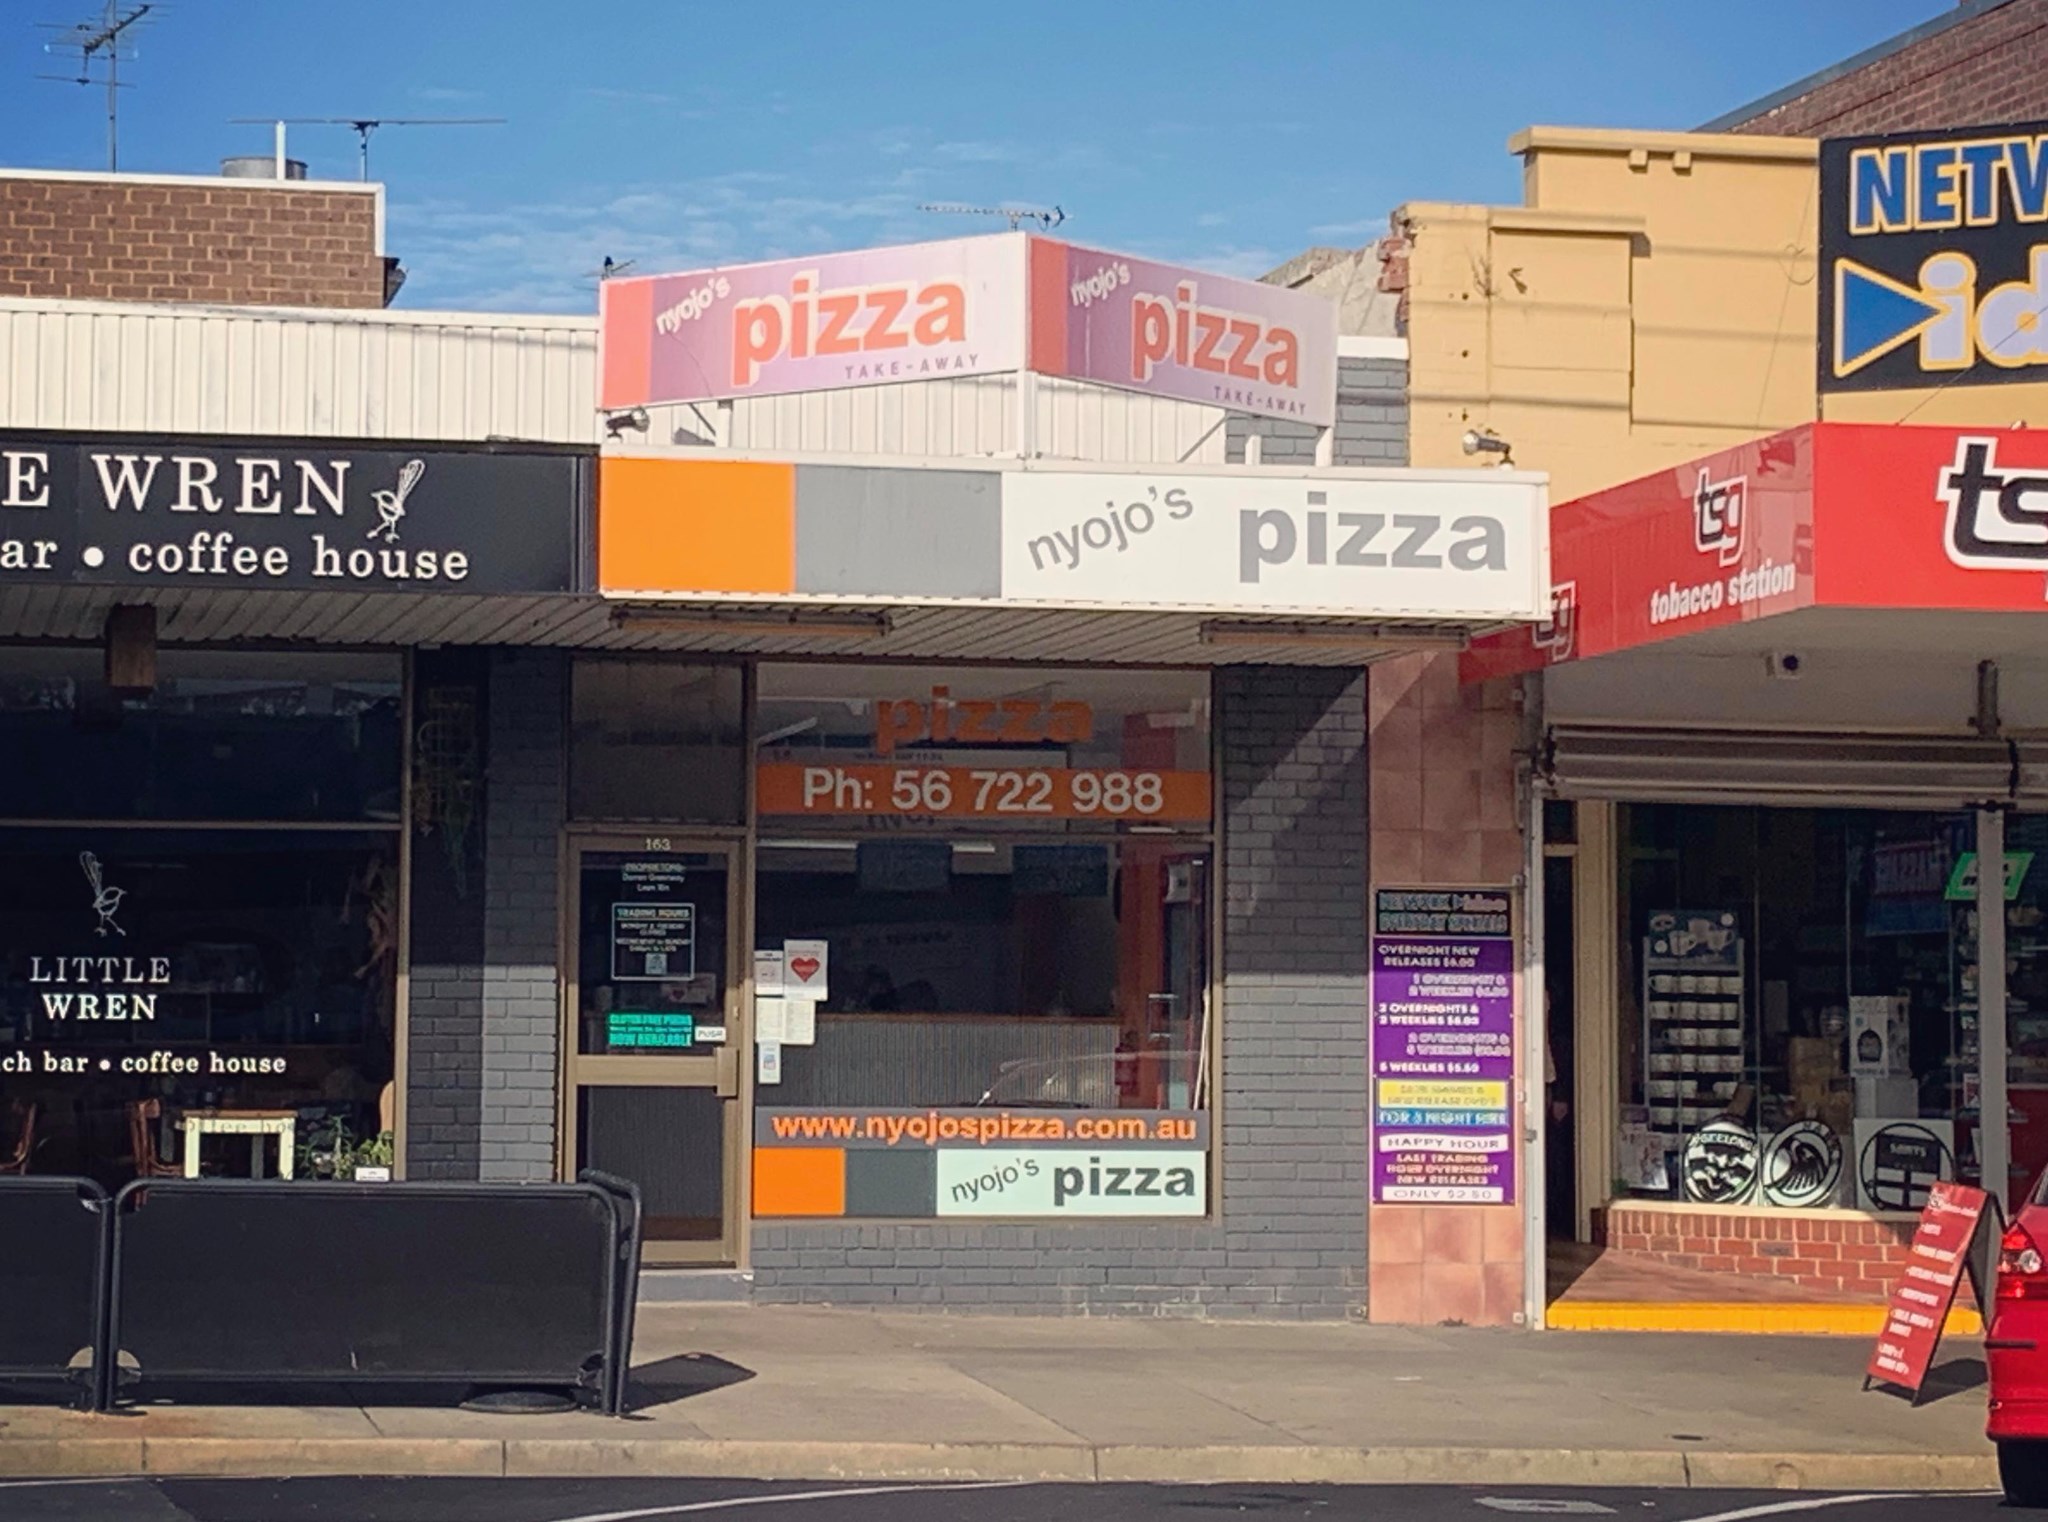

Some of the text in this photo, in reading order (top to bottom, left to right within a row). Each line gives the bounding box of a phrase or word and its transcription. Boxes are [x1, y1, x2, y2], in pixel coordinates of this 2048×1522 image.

[1071, 261, 1131, 308] nyojo's
[656, 275, 731, 335] nyojo's
[731, 269, 968, 387] pizza
[1131, 279, 1299, 389] pizza
[845, 354, 980, 380] TAKE-AWAY
[1213, 386, 1307, 416] TAKE-AWAY
[3, 452, 352, 516] E WREN
[1027, 485, 1194, 572] nyojo's
[1694, 465, 1748, 568] tsg
[1239, 491, 1509, 583] pizza
[128, 532, 289, 576] coffee
[312, 536, 468, 580] house
[1650, 558, 1796, 626] tobacco station
[877, 685, 1094, 754] pizza
[804, 768, 1164, 814] Ph: 56 722 988
[646, 837, 671, 851] 163
[1378, 944, 1480, 956] OVERNIGHT NEW
[1383, 956, 1441, 967] RELEASES
[29, 956, 171, 983] LITTLE
[42, 994, 158, 1021] WREN
[1389, 1002, 1468, 1014] OVERNIGHTS
[1389, 1014, 1445, 1026] WEEKLIES
[697, 1029, 723, 1038] PUSH
[2, 1050, 287, 1073] ch bar coffee house
[1389, 1062, 1446, 1073] WEEKLIES
[771, 1112, 1197, 1146] www.nyojospizza.com.au
[1387, 1138, 1500, 1149] HAPPY HOUR
[1396, 1154, 1489, 1164] LAST TRADING
[1425, 1164, 1499, 1175] OVERNIGHT
[950, 1158, 1040, 1203] nyojo's
[1053, 1156, 1196, 1206] pizza
[1393, 1189, 1441, 1199] ONLY
[1396, 1175, 1489, 1185] NEW RELEASES
